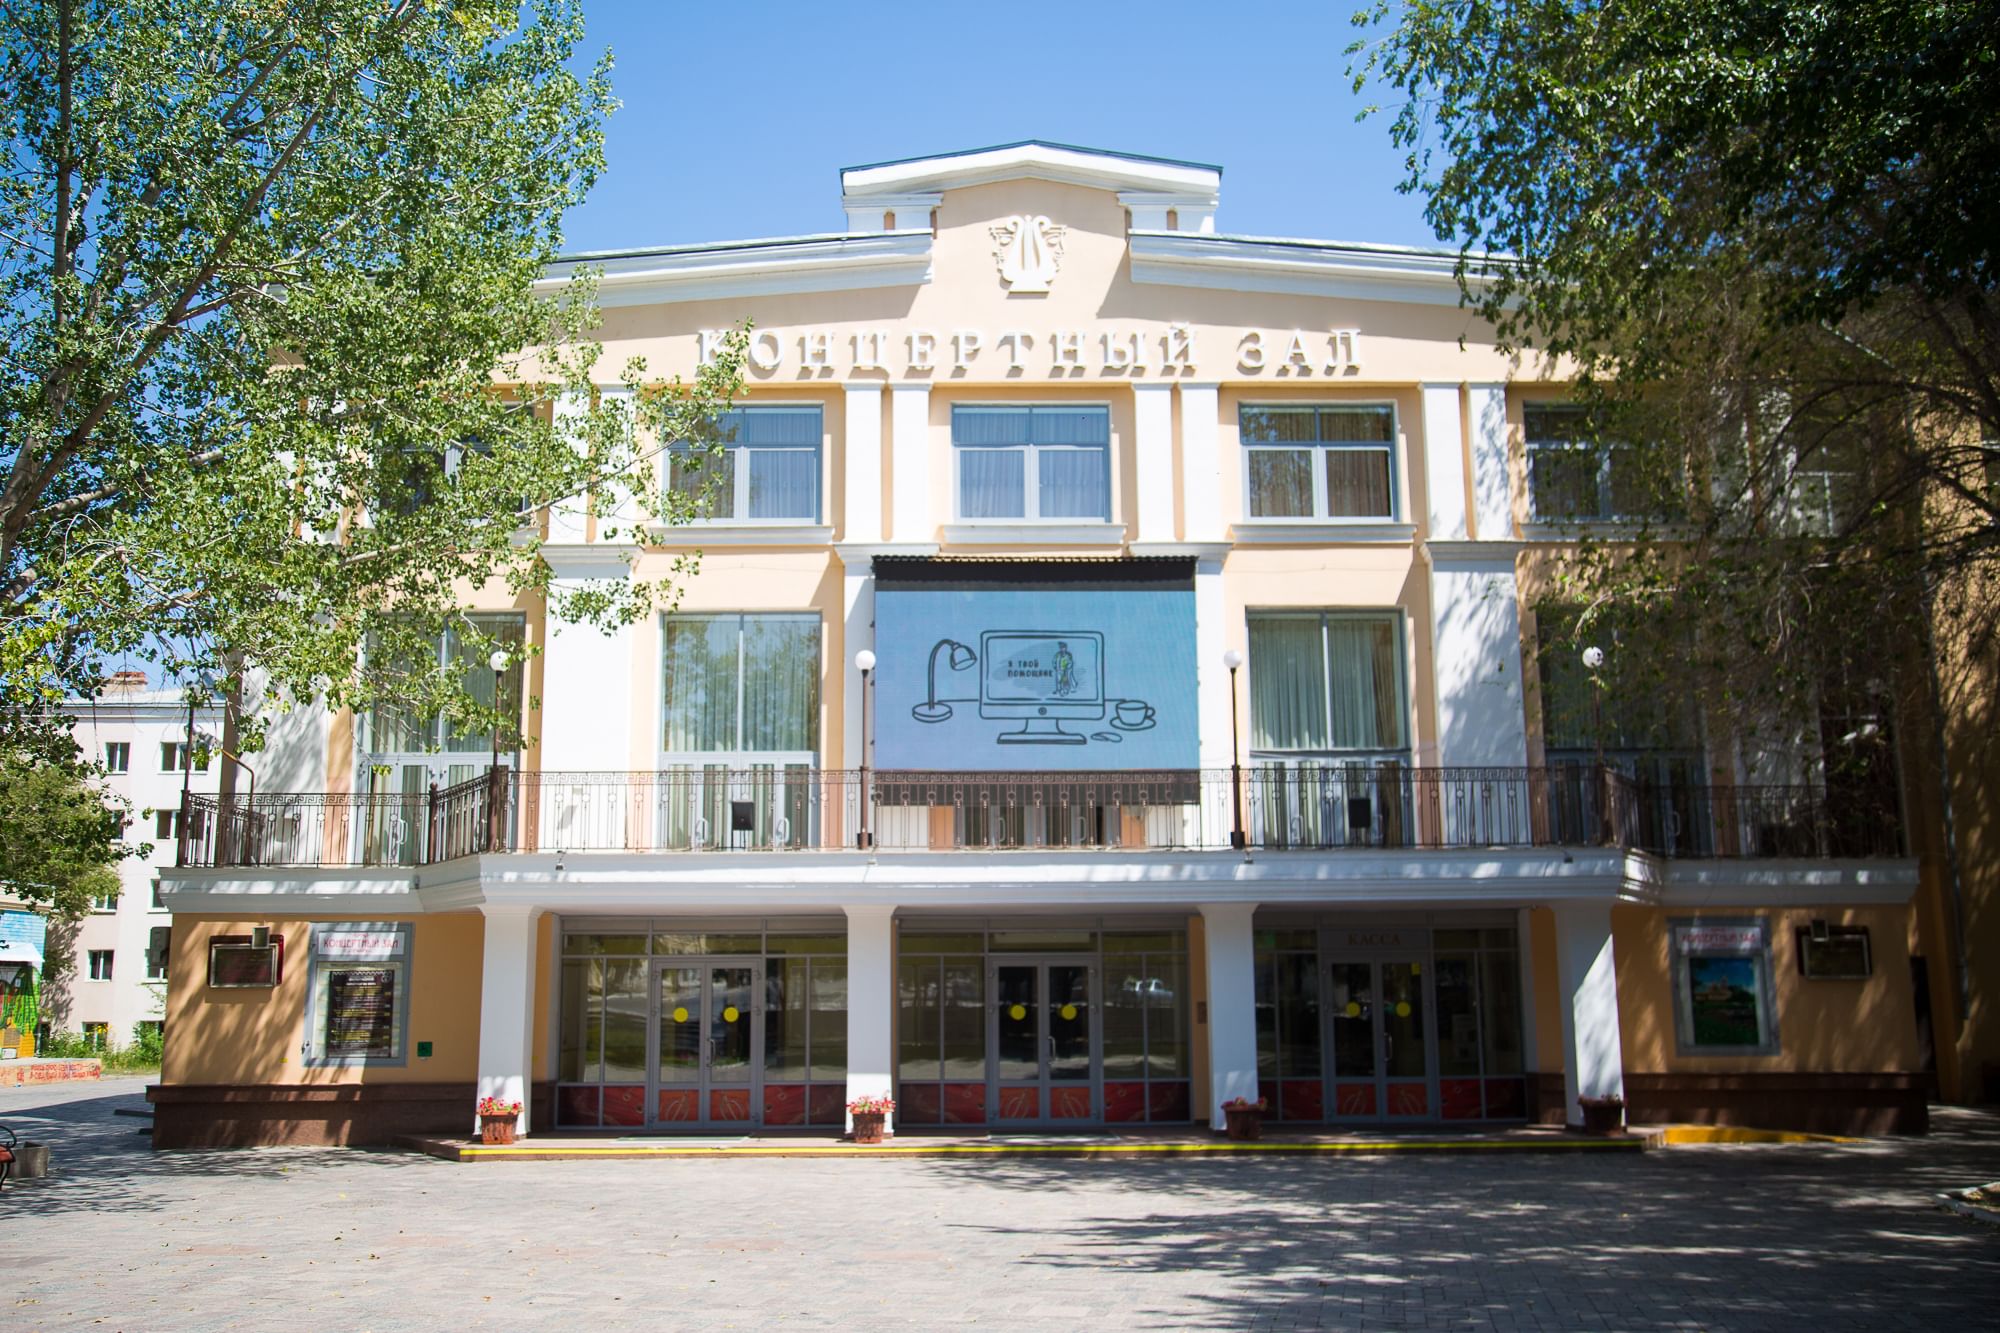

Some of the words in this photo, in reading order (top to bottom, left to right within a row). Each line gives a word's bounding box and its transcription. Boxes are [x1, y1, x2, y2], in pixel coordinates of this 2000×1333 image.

[698, 322, 1199, 370] КОНЦЕРТНЫЙ
[1236, 328, 1363, 368] ЗАЛ
[1347, 933, 1401, 946] КАССА
